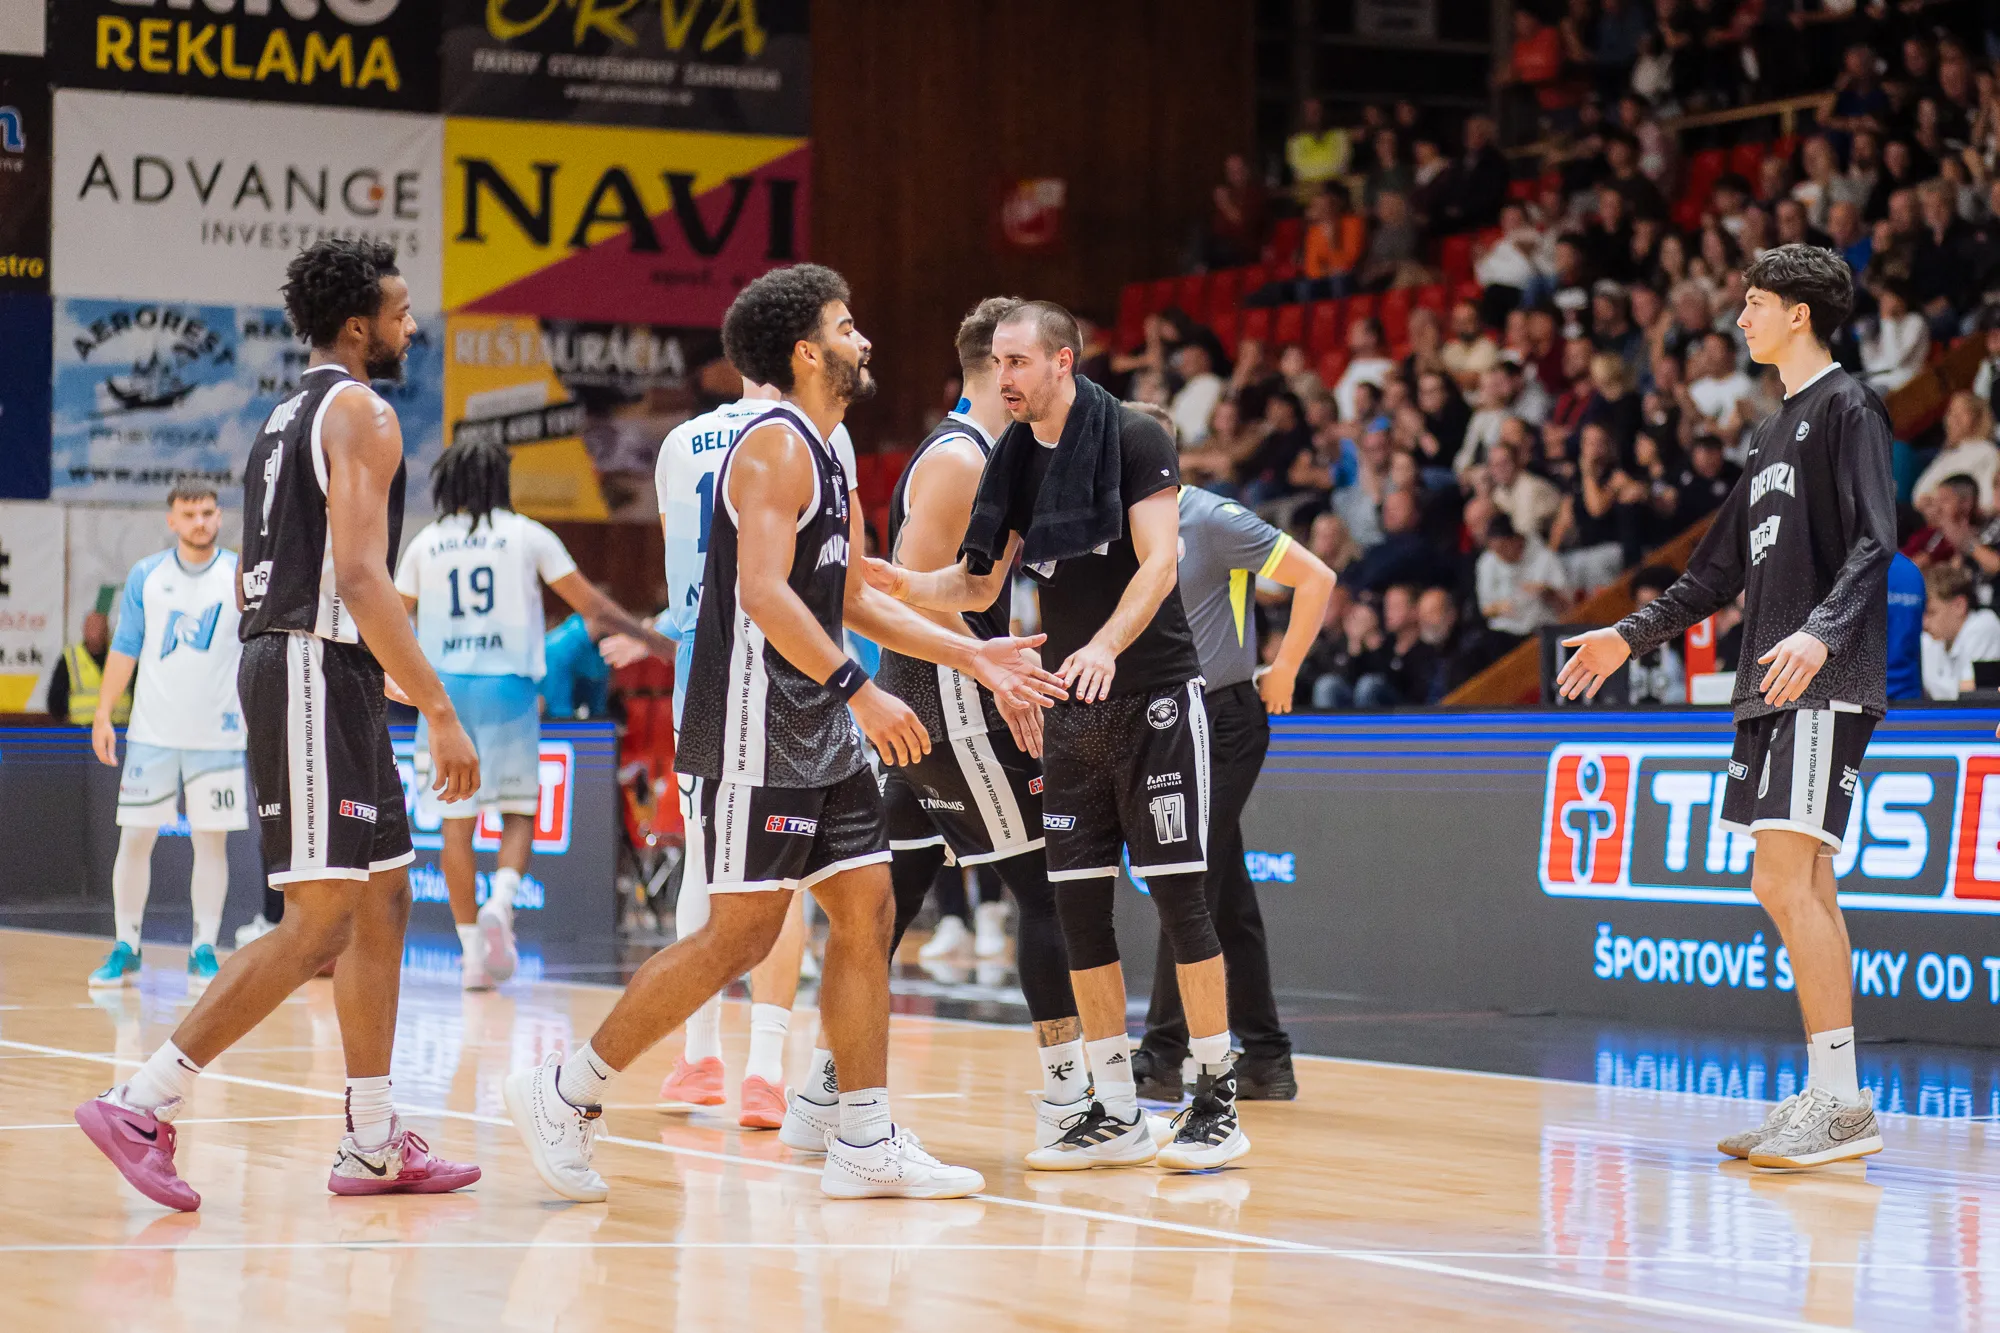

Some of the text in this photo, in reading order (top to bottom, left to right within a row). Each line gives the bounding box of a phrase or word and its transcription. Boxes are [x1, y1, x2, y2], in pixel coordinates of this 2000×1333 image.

[96, 15, 400, 92] REKLAMA
[79, 152, 421, 220] ADVANCE
[455, 156, 798, 261] NAVI
[447, 565, 495, 618] 19
[442, 633, 504, 655] NITRA
[740, 705, 748, 743] PRIEVIDZA
[1808, 754, 1817, 788] PRIEVIDZA
[210, 787, 235, 812] 30
[1149, 793, 1187, 844] 17
[1594, 923, 1768, 990] ŠPORTOVÉ
[1915, 952, 1974, 1001] OD
